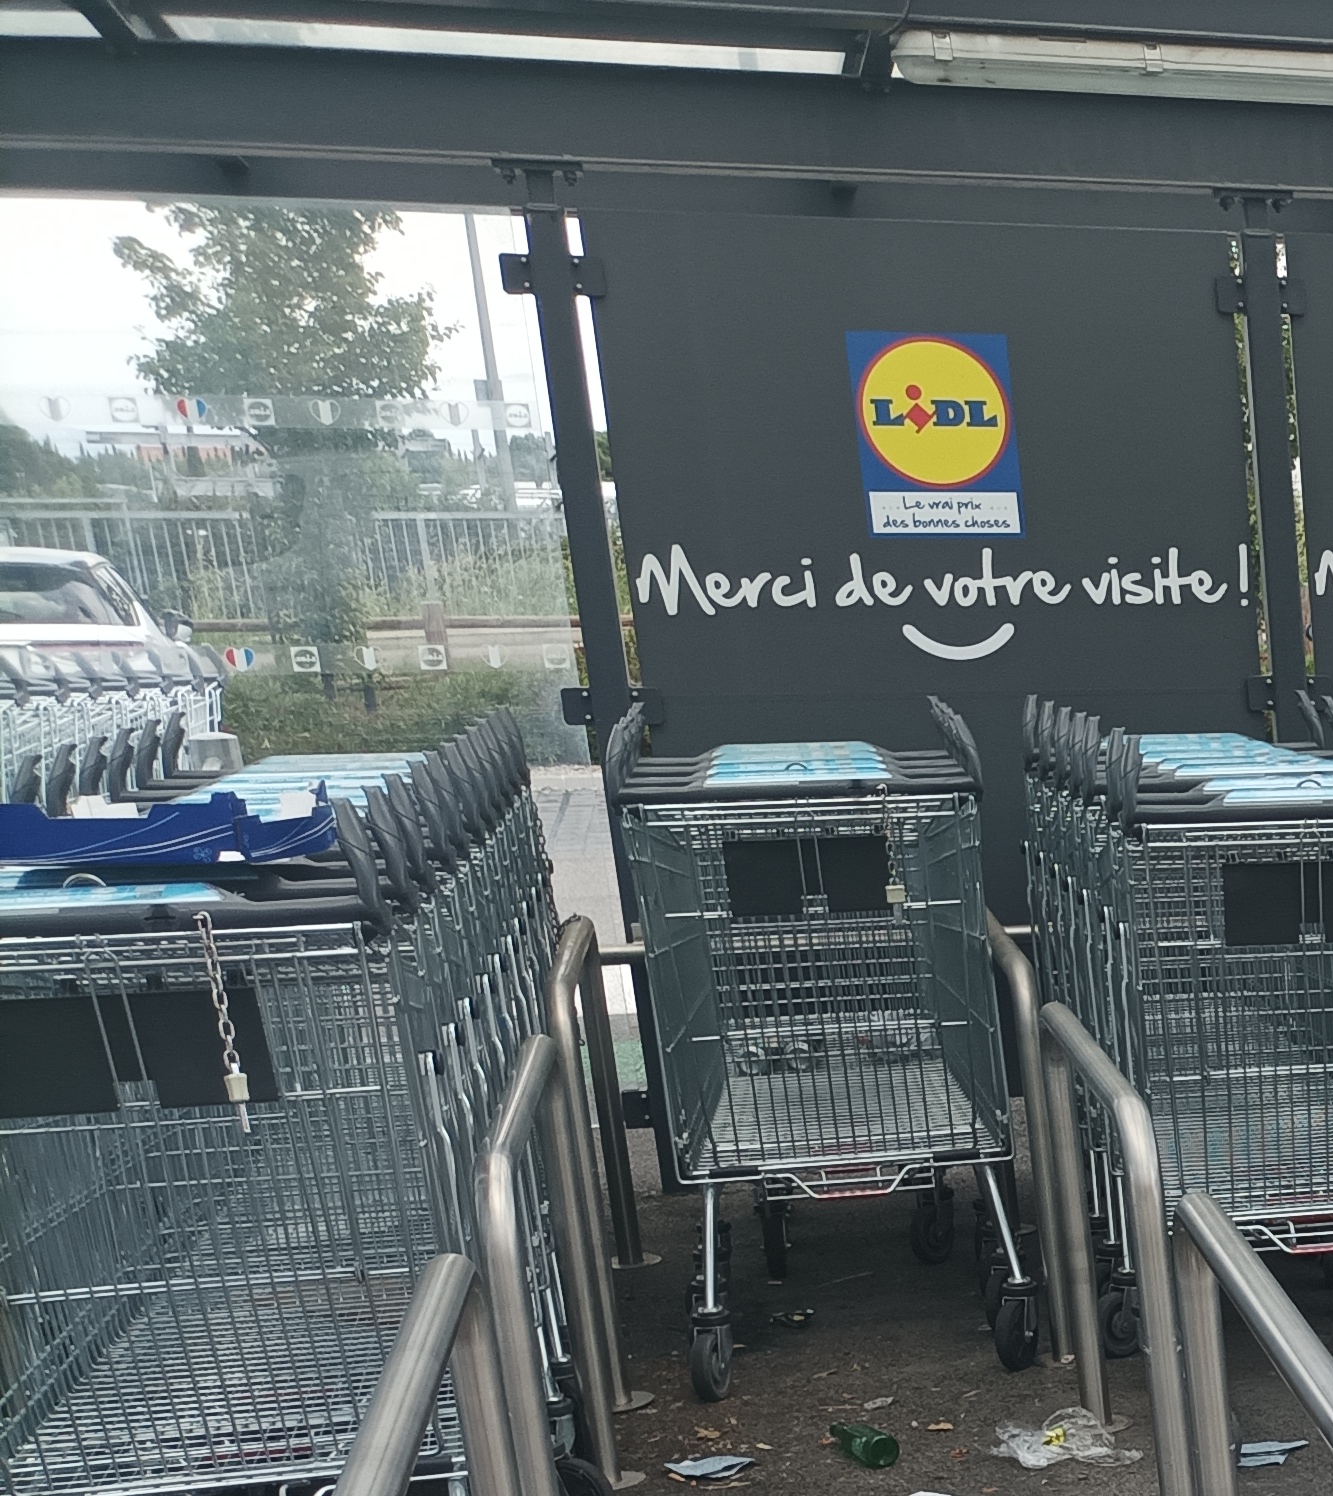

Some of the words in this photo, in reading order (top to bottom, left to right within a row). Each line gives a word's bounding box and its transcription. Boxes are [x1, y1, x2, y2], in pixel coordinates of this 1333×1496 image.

[902, 496, 925, 510] Le
[928, 497, 953, 511] vrai
[957, 497, 982, 514] prix
[883, 515, 909, 528] des
[912, 513, 960, 528] bonnes
[965, 515, 1011, 528] choses
[637, 544, 818, 616] Merci
[835, 553, 913, 608] de
[923, 547, 1073, 608] votre
